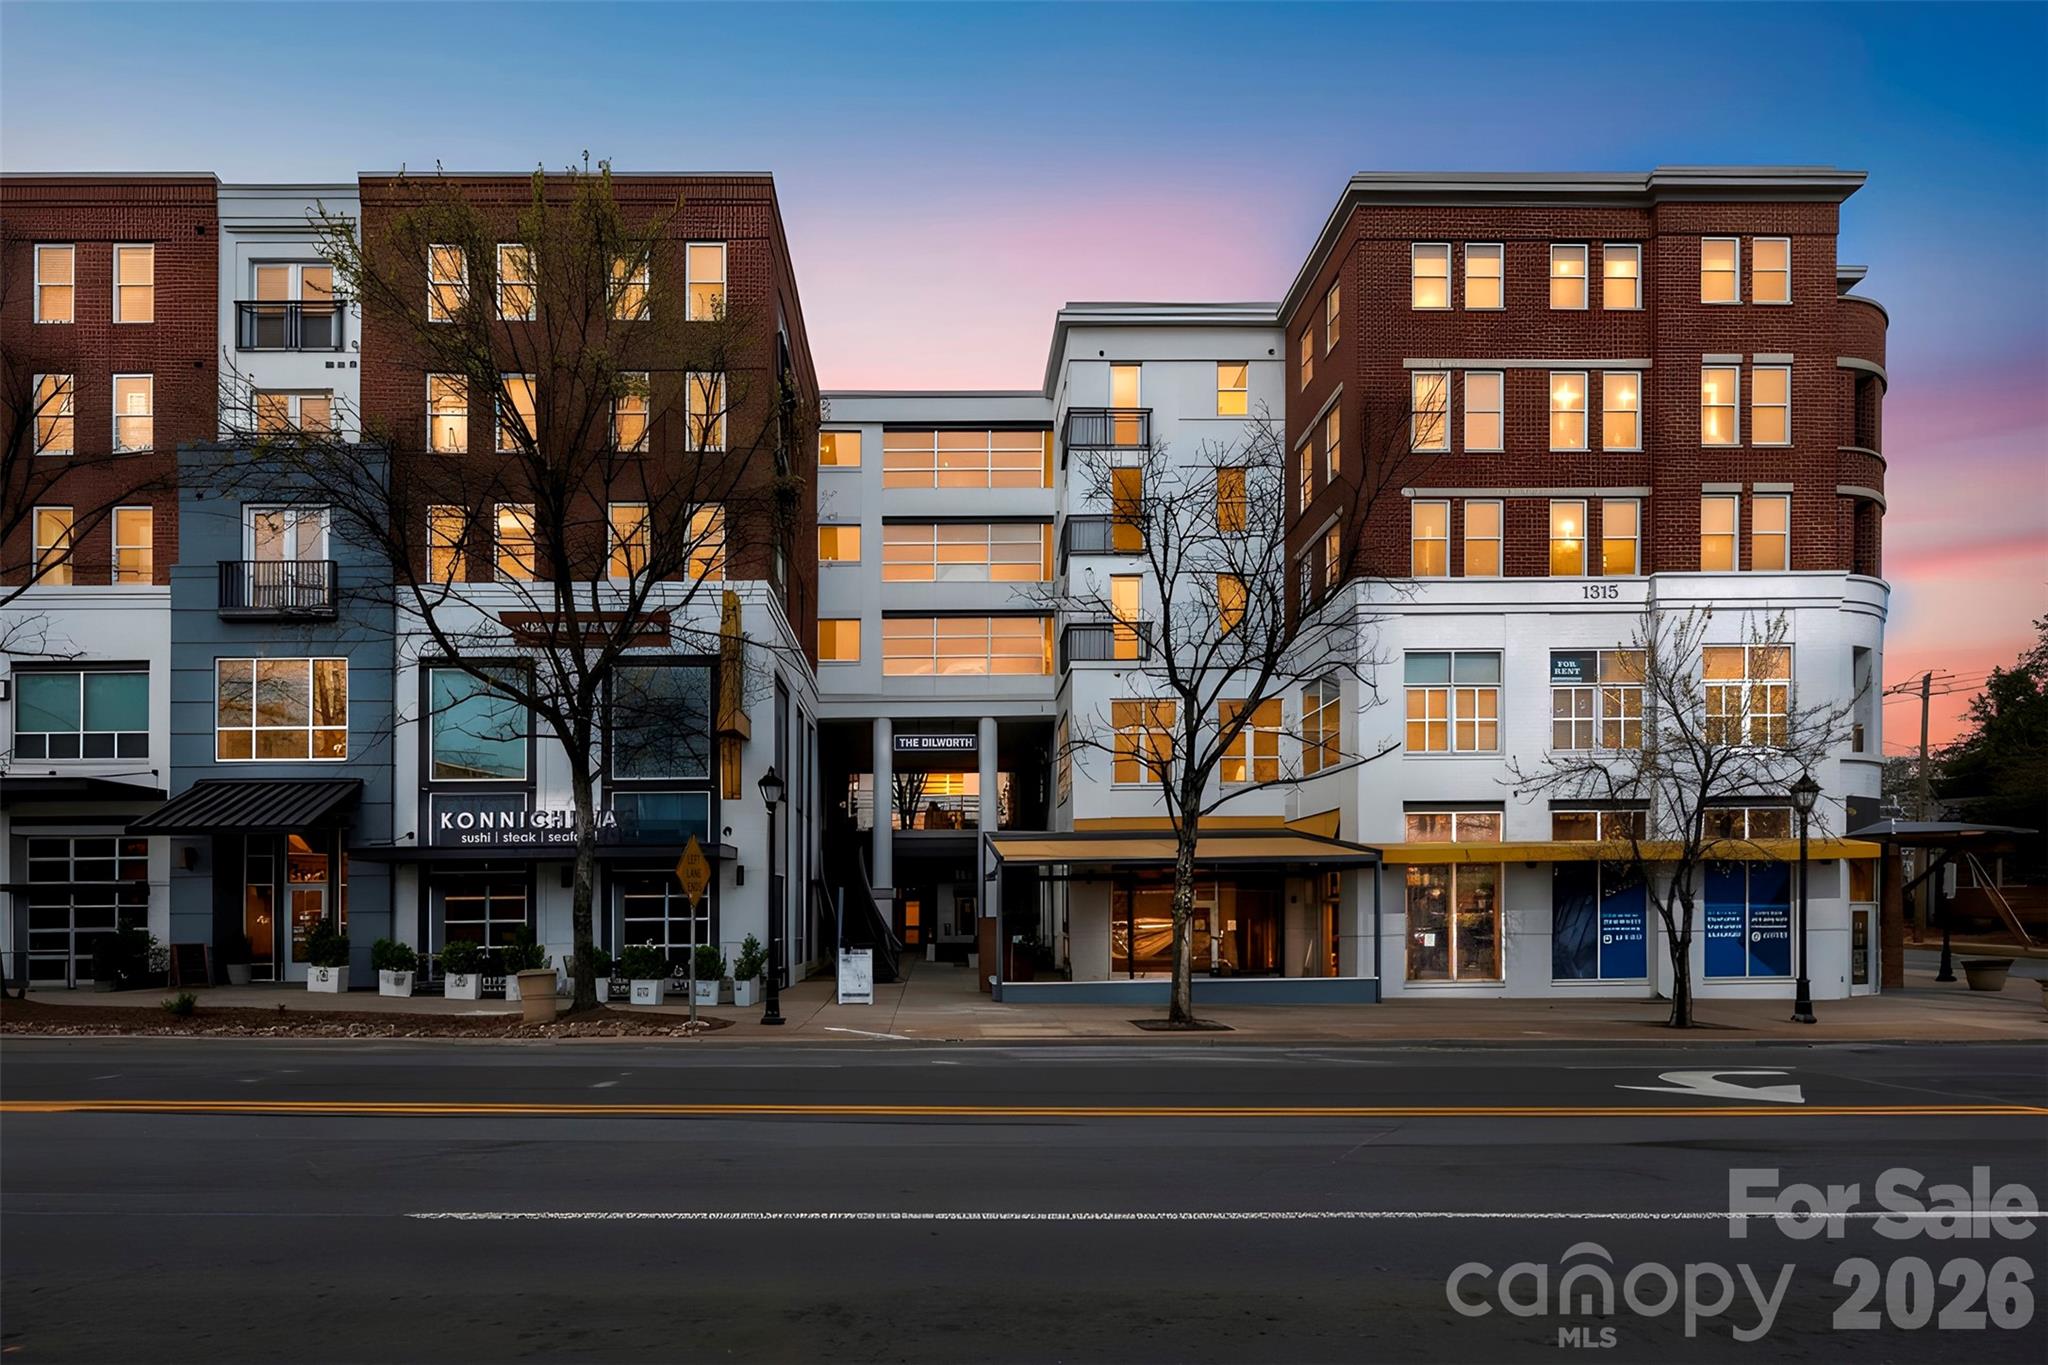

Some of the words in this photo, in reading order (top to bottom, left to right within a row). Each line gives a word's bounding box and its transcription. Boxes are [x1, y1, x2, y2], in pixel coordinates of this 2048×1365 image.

[1582, 584, 1619, 599] 1315
[899, 738, 919, 747] THE
[922, 738, 973, 747] DILWORTH
[461, 832, 491, 843] sushi
[503, 832, 536, 843] steak
[687, 854, 702, 865] LEFT
[686, 868, 702, 879] LANE
